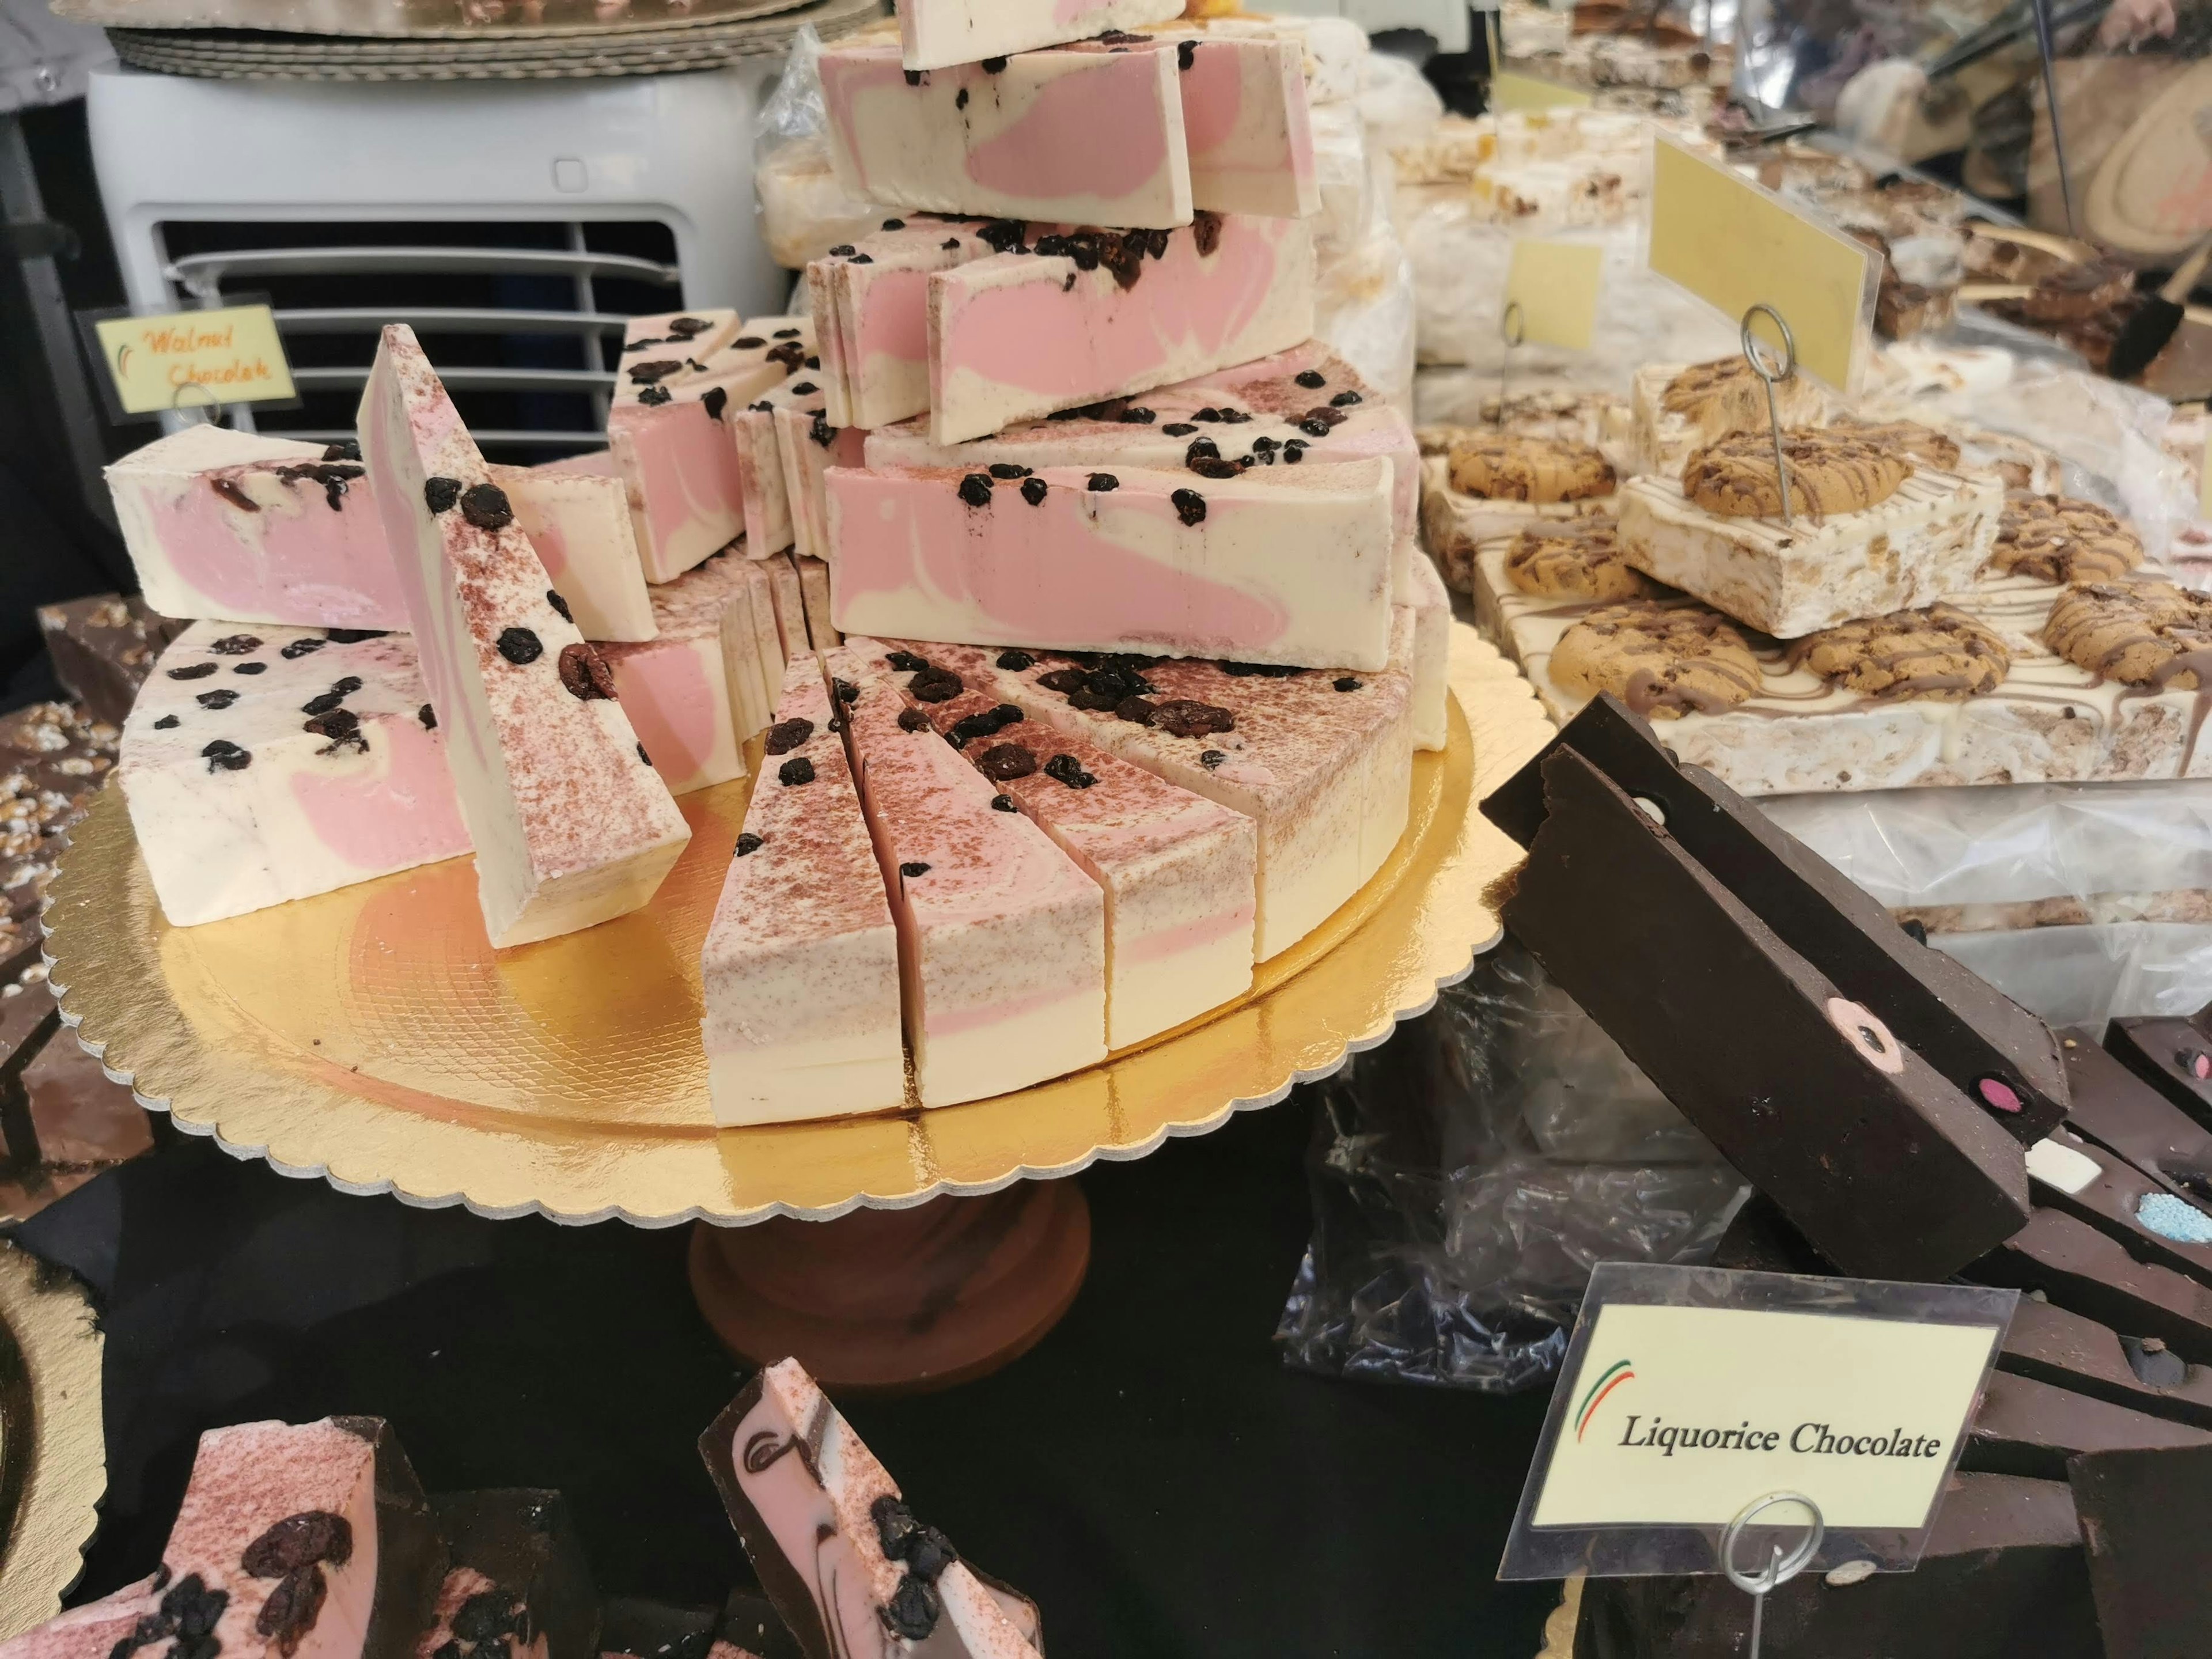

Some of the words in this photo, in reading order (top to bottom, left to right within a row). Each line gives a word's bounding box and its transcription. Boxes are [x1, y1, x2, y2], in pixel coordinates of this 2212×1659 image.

[142, 324, 233, 354] Walnut
[1618, 1415, 1779, 1456] Liquorice
[1789, 1422, 1941, 1458] Chocolate
